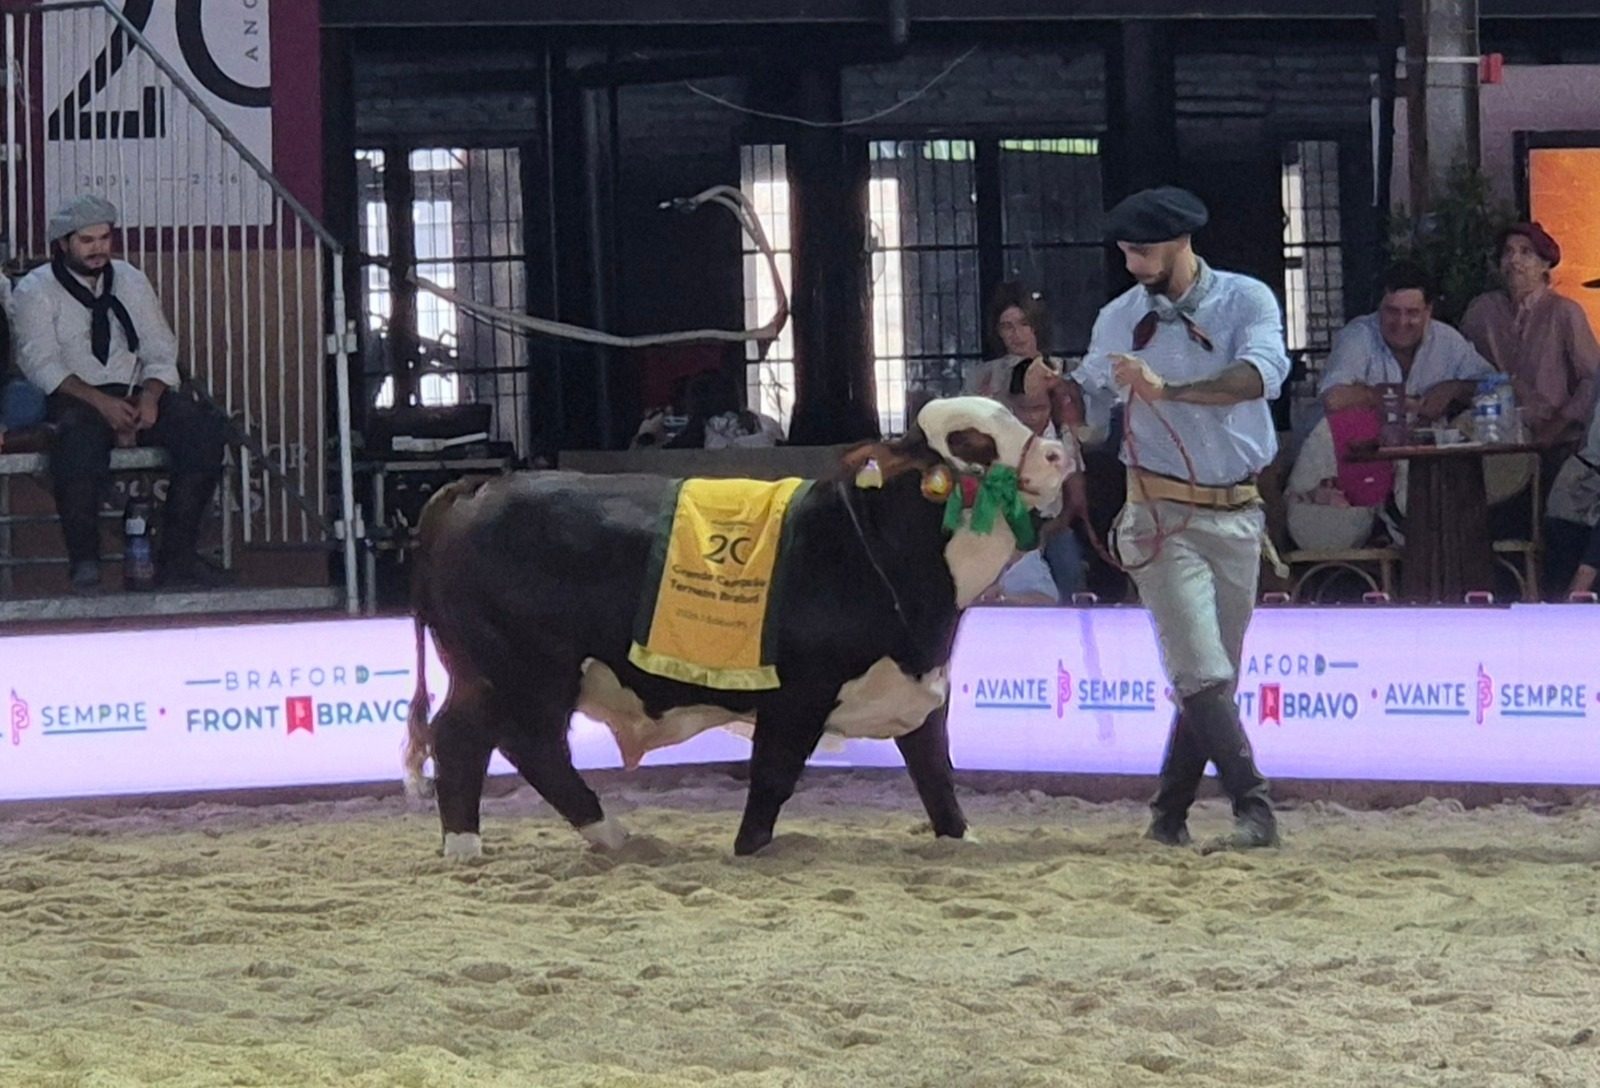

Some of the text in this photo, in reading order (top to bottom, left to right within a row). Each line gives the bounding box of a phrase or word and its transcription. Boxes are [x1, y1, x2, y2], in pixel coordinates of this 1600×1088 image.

[224, 664, 370, 691] BRAFORD
[1246, 653, 1327, 676] AFORD
[975, 678, 1156, 703] AVANTE SEMPRE
[1384, 682, 1587, 709] AVANTE SEMPRE
[41, 701, 147, 728] SEMPRE
[186, 699, 410, 732] FRONT BRAVO
[1283, 692, 1359, 719] BRAVO
